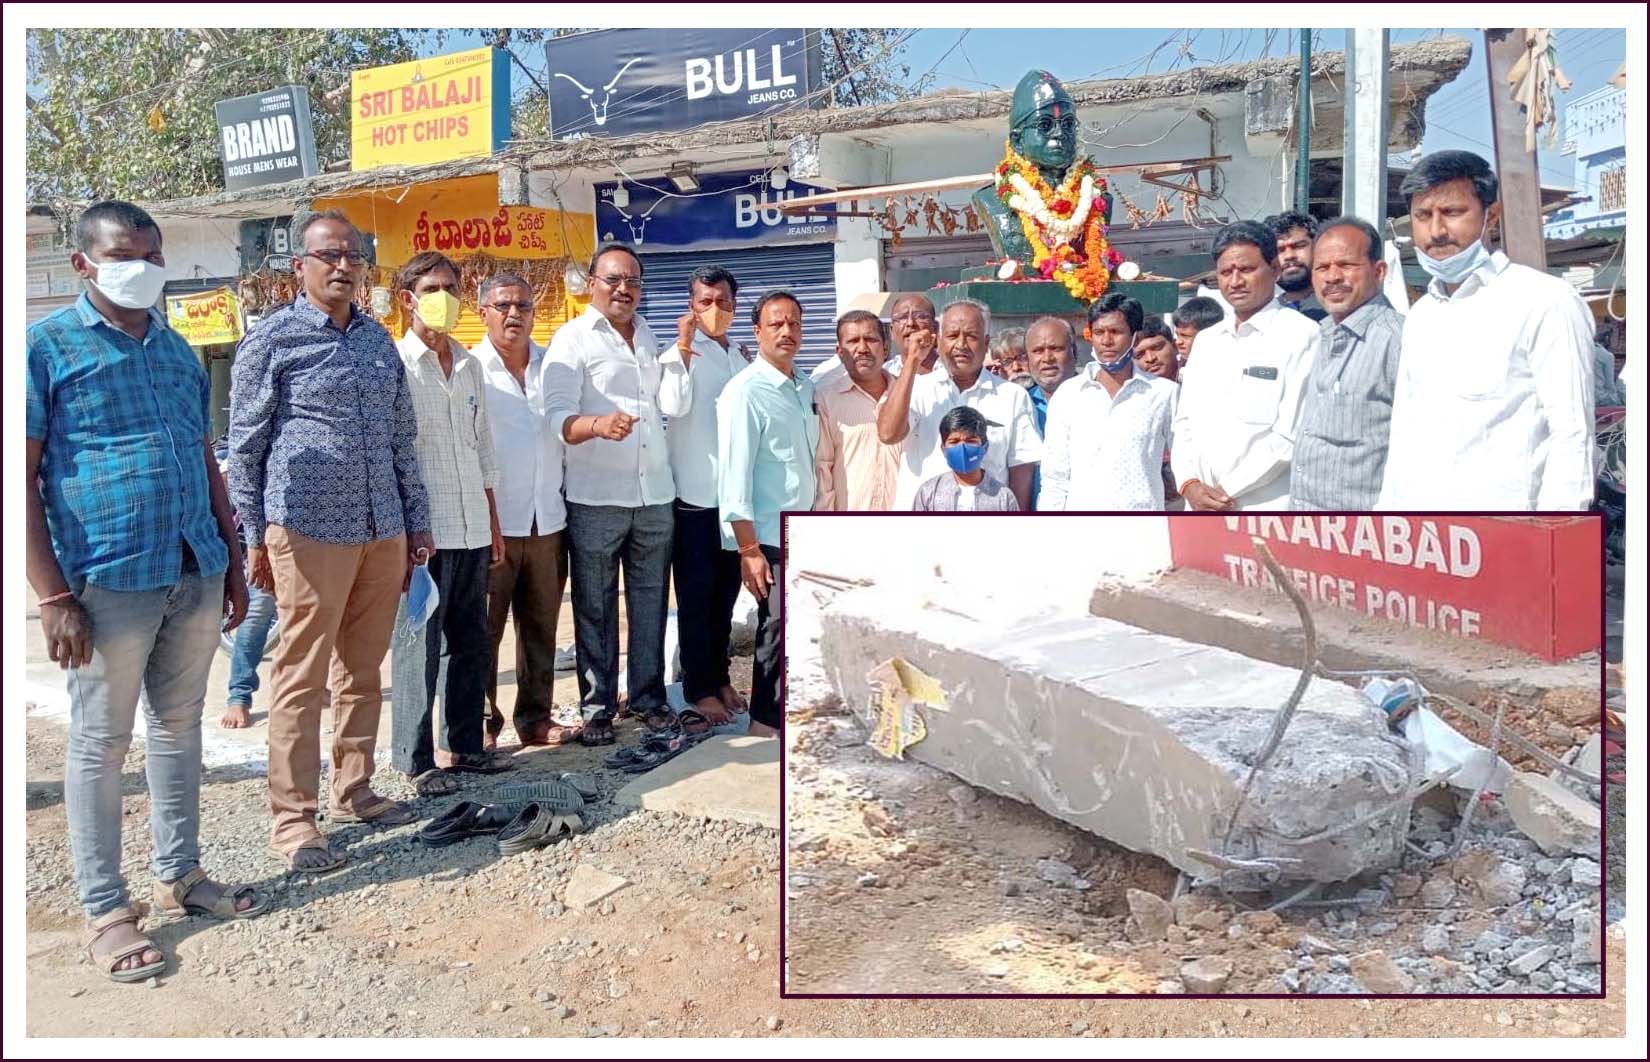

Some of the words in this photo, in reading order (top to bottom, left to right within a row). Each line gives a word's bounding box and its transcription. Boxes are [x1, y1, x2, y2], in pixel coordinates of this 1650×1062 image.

[686, 44, 797, 100] BULL
[360, 90, 394, 118] SRI
[401, 75, 482, 113] BALAJI
[748, 91, 778, 104] JEANS
[780, 88, 797, 99] CO.
[223, 114, 295, 162] BRAND
[372, 123, 407, 148] HOT
[413, 115, 469, 142] CHIPS
[228, 164, 252, 177] HOUSE
[253, 160, 275, 174] MENS
[275, 156, 298, 169] WEAR
[735, 187, 828, 229] BULL
[786, 226, 812, 236] JEANS
[1224, 554, 1356, 609] TRAFICE
[1366, 585, 1480, 637] POLICE
